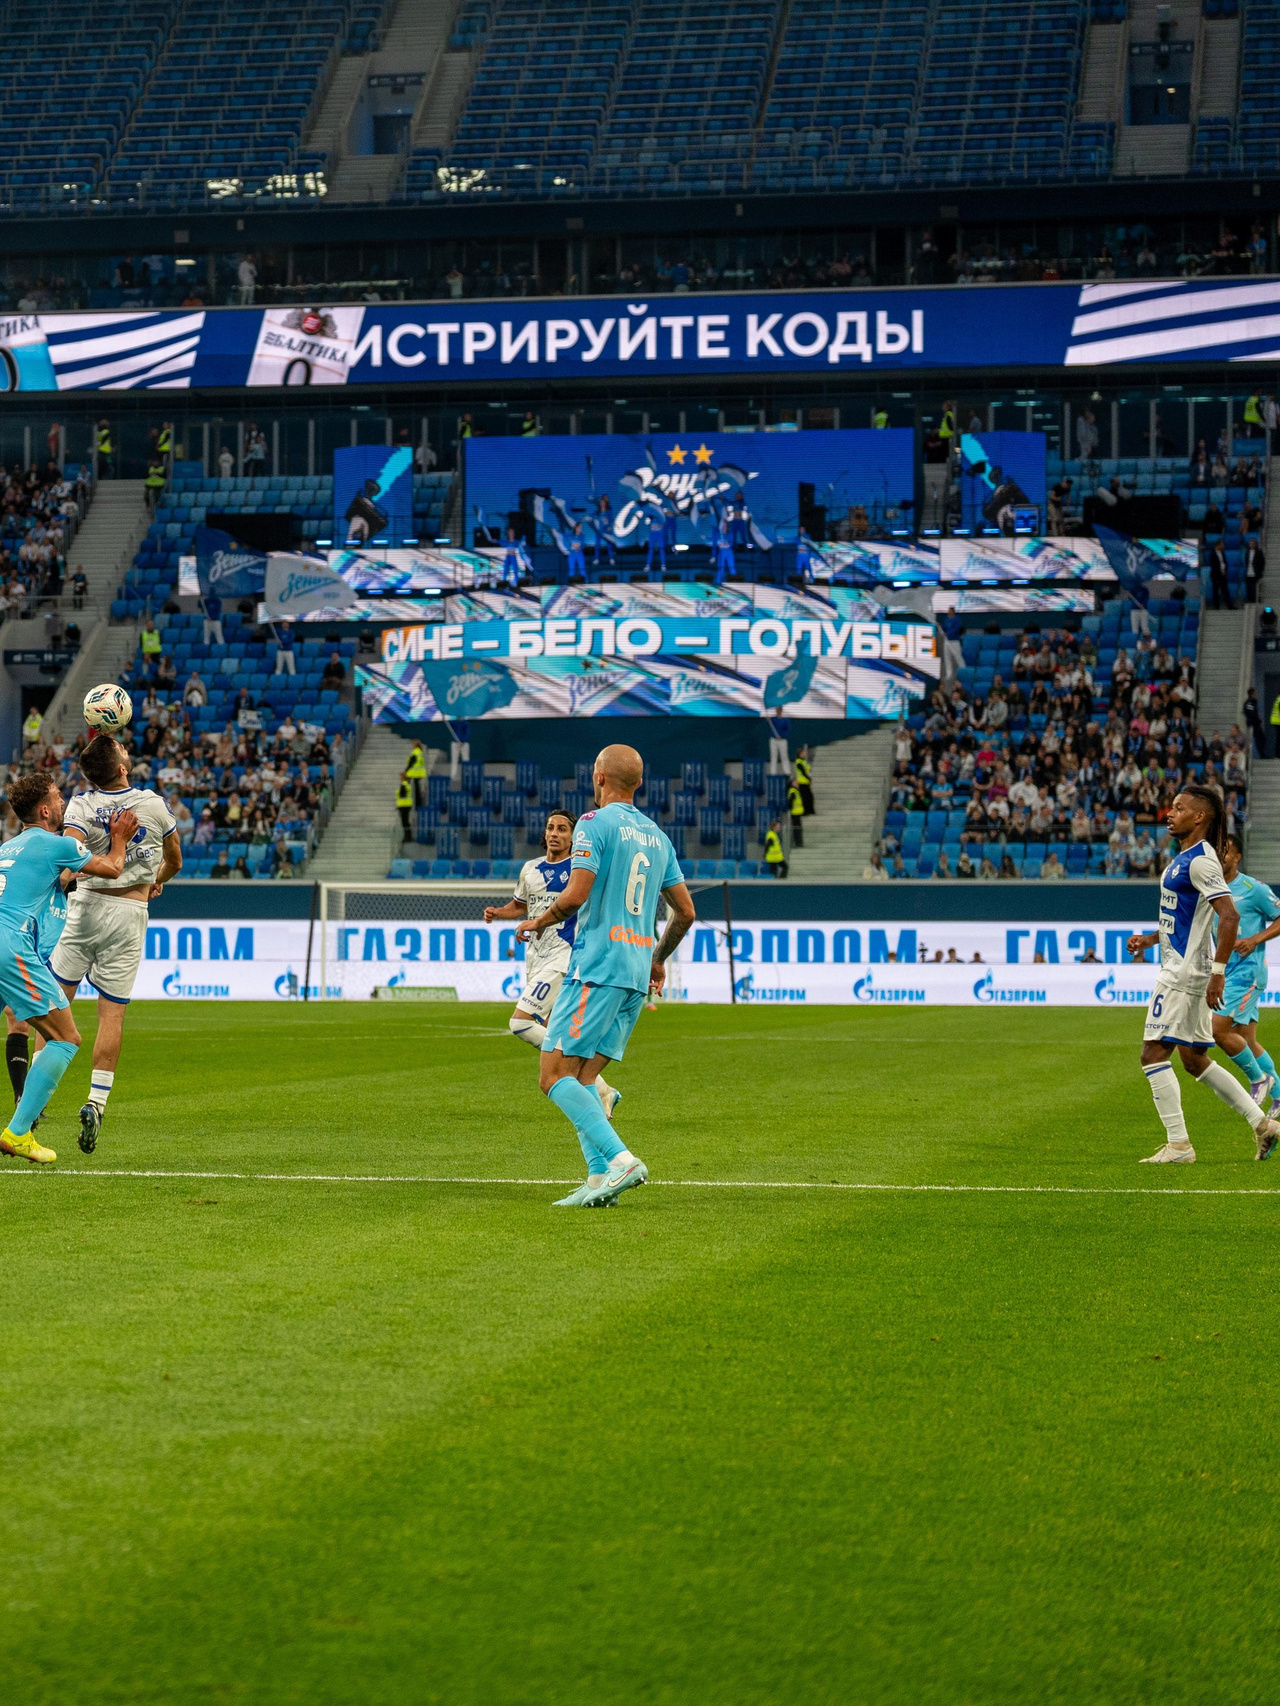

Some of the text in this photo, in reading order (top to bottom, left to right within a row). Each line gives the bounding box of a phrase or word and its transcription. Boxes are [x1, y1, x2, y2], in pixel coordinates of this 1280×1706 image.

[273, 333, 348, 362] БАЛТИКА
[746, 309, 924, 363] КОДЫ
[383, 624, 464, 662] СИНЕ
[509, 618, 663, 656] БЕЛО
[719, 618, 933, 660] ГОЛУБЫЕ
[625, 852, 650, 916] 6
[336, 928, 526, 961] ГАЗПРО
[686, 929, 917, 963] АЗПРОМ
[182, 984, 229, 997] ГАЗПРОМ
[531, 981, 551, 1001] 10
[754, 988, 806, 1000] ГАЗПРОМ
[874, 989, 925, 1001] ГАЗПРОМ
[994, 990, 1046, 1002] ГАЗПРОМ
[1117, 991, 1152, 1003] ГАЗПР
[1152, 995, 1164, 1018] 6
